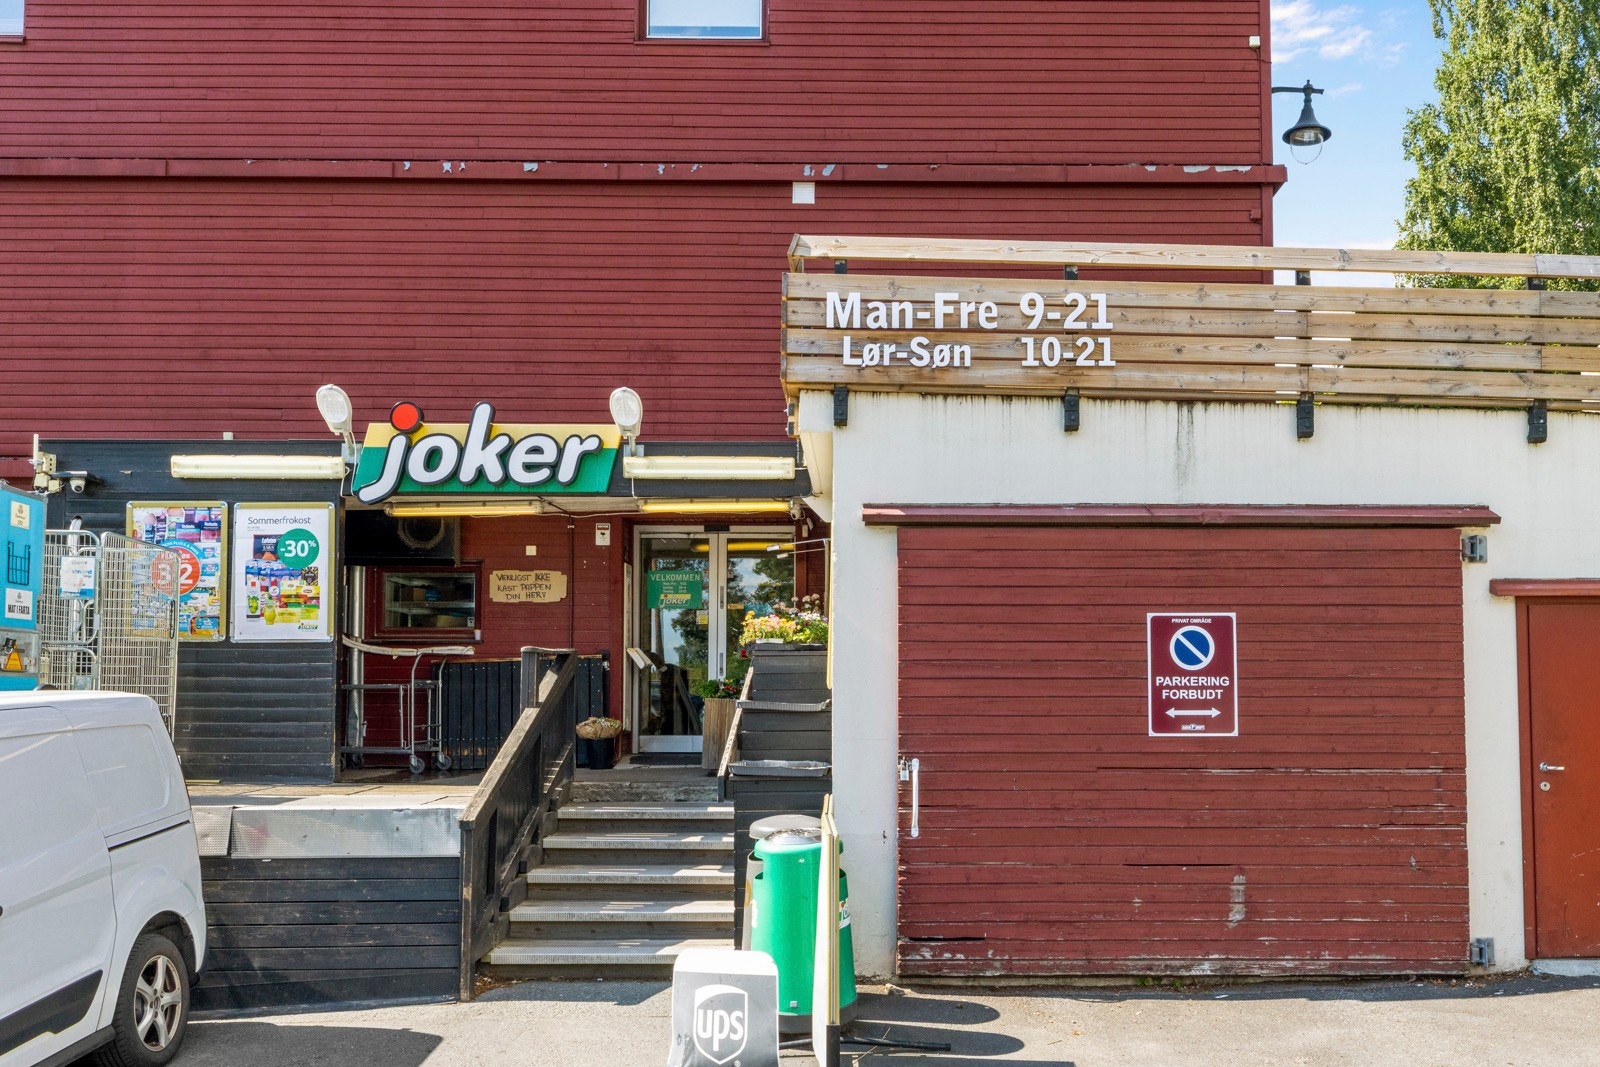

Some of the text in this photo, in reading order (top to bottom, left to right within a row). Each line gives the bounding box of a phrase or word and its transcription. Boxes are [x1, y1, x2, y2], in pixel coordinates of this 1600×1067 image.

[825, 291, 1114, 330] Man-Fre 9-21
[842, 336, 1117, 369] Lør-Søn 10-21
[357, 401, 603, 505] joker
[247, 516, 312, 525] Sommerfrokost
[496, 573, 550, 582] VENLIGST IKKE
[650, 573, 701, 581] VELKOMMEN
[497, 583, 552, 592] KAST PAPPEN
[1156, 676, 1230, 687] PARKERING
[1162, 689, 1224, 700] FORBUDT
[696, 1008, 744, 1052] ups
